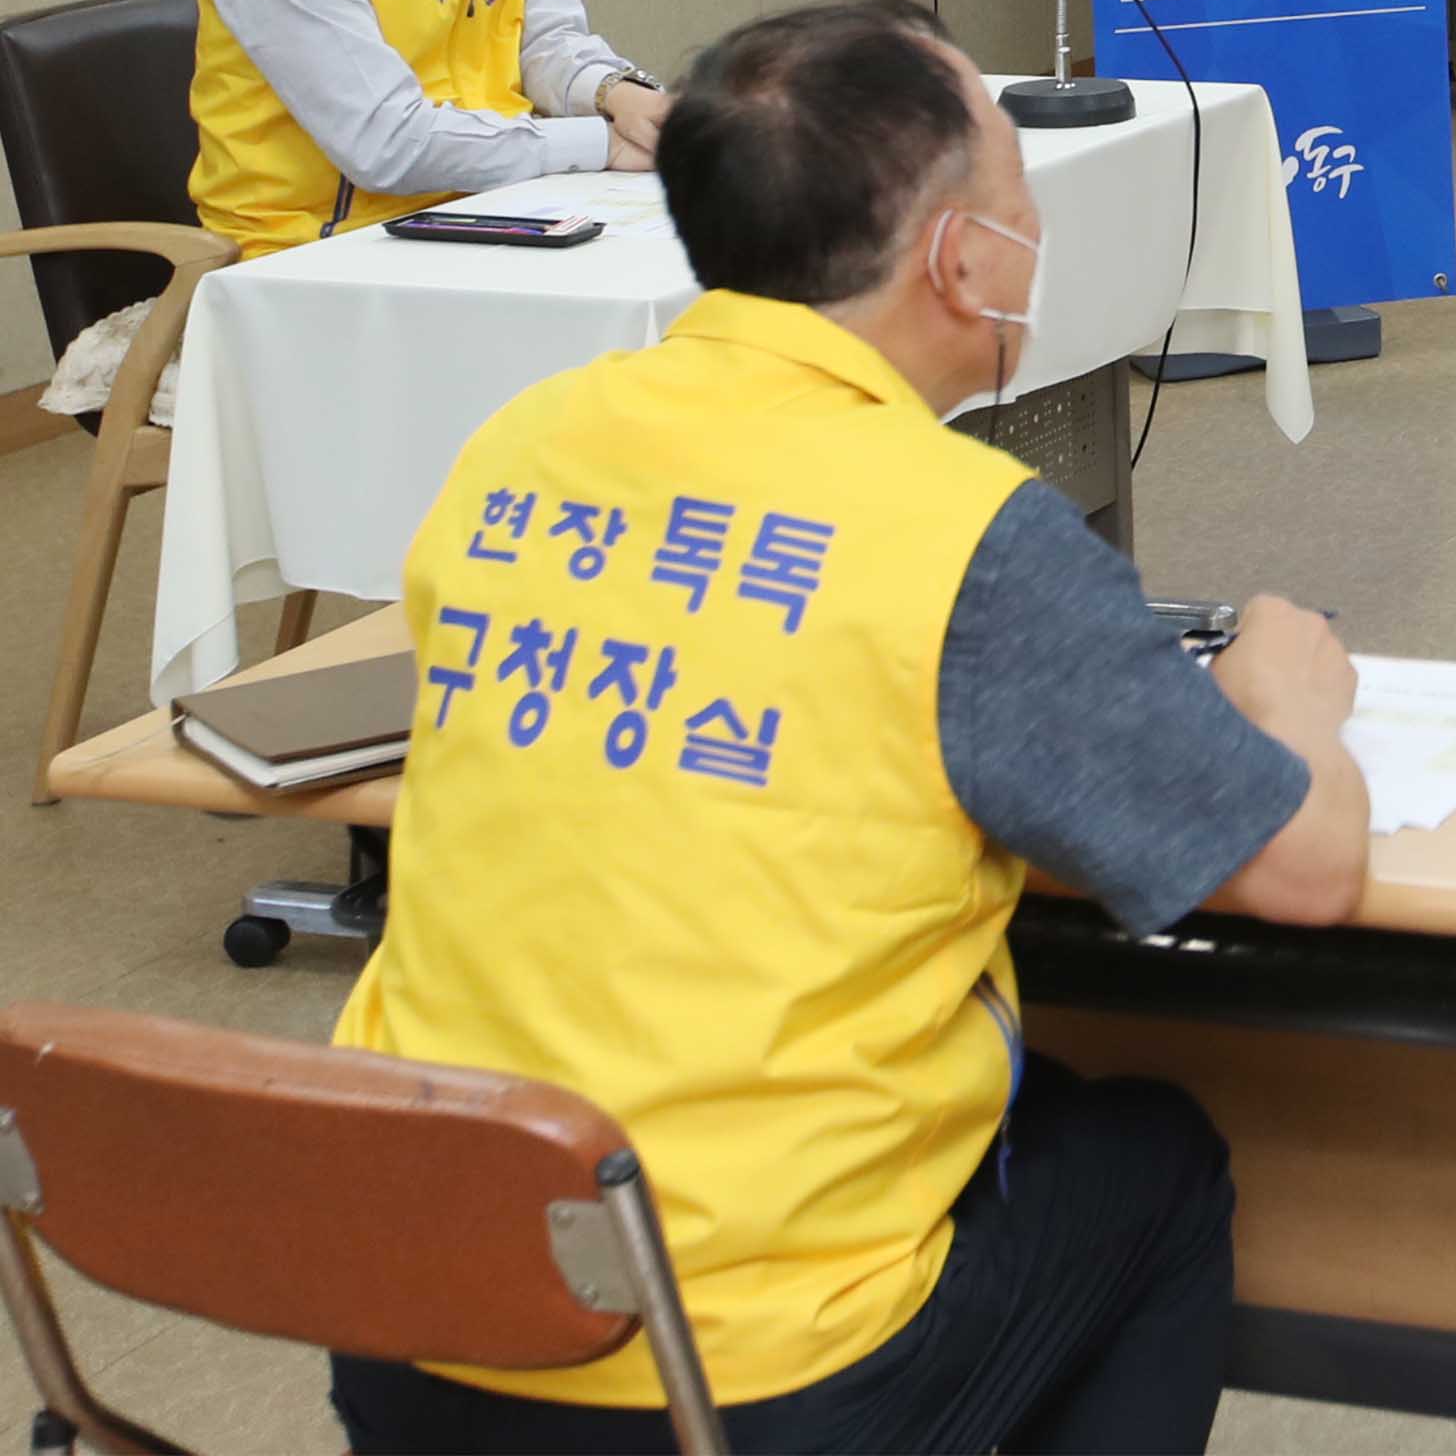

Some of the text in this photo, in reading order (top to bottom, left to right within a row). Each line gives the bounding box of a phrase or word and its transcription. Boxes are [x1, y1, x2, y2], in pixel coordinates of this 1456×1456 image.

[466, 487, 836, 636] 현장 톡톡
[427, 605, 782, 788] 구청장실
